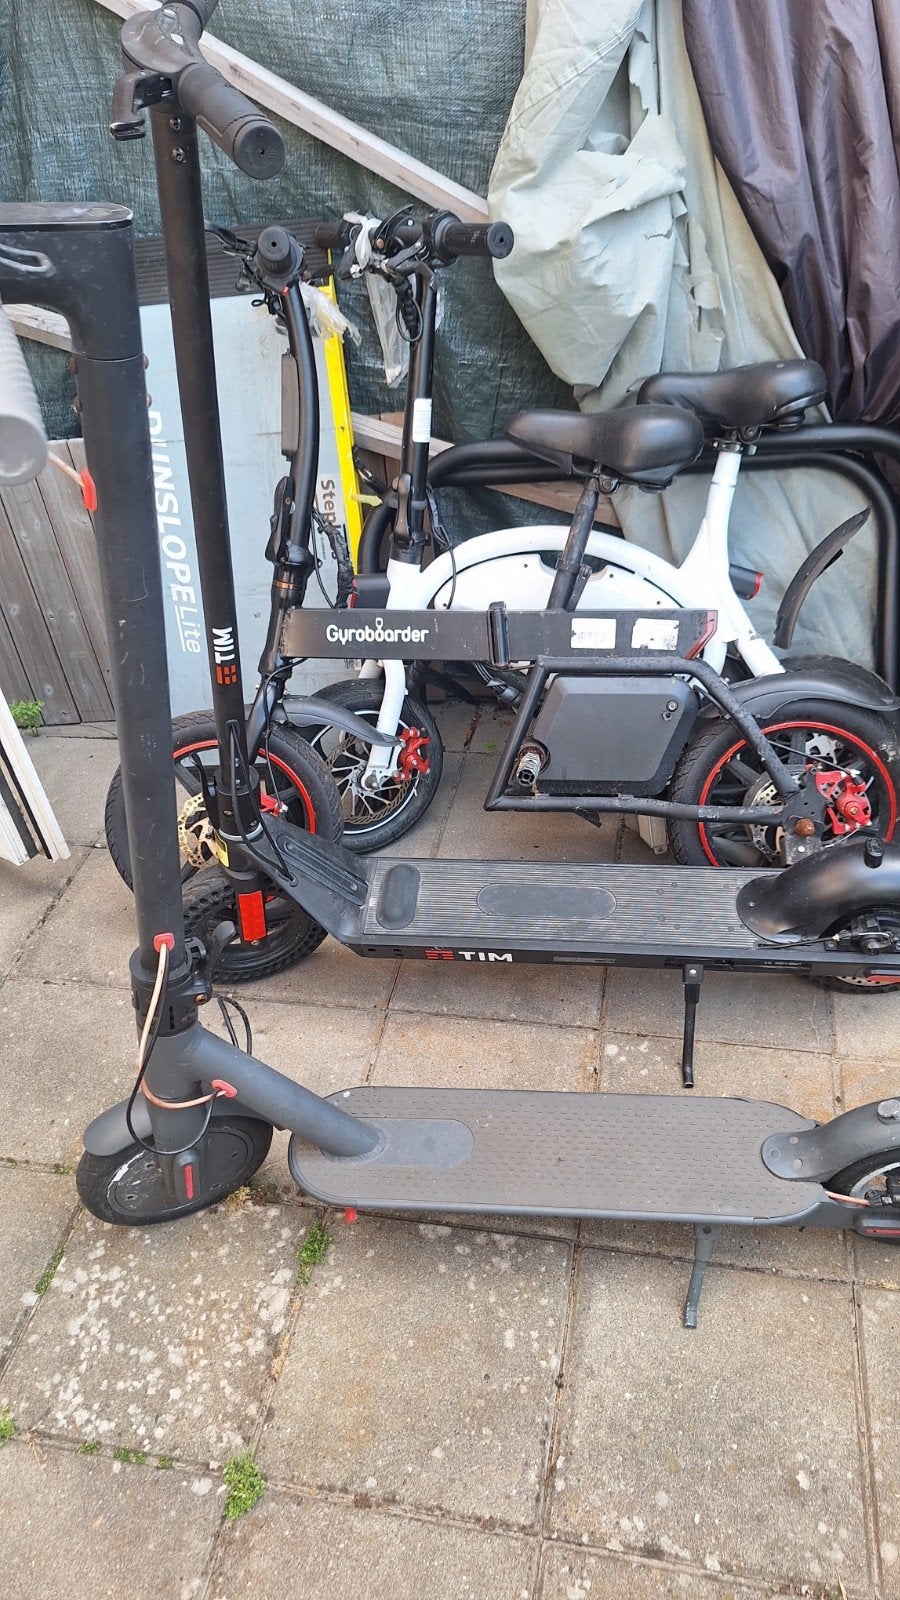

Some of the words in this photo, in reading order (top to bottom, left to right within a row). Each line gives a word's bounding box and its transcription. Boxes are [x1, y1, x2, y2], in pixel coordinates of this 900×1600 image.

[212, 626, 236, 664] TIM
[326, 617, 430, 646] Gyroboarder
[458, 951, 513, 963] TIM
